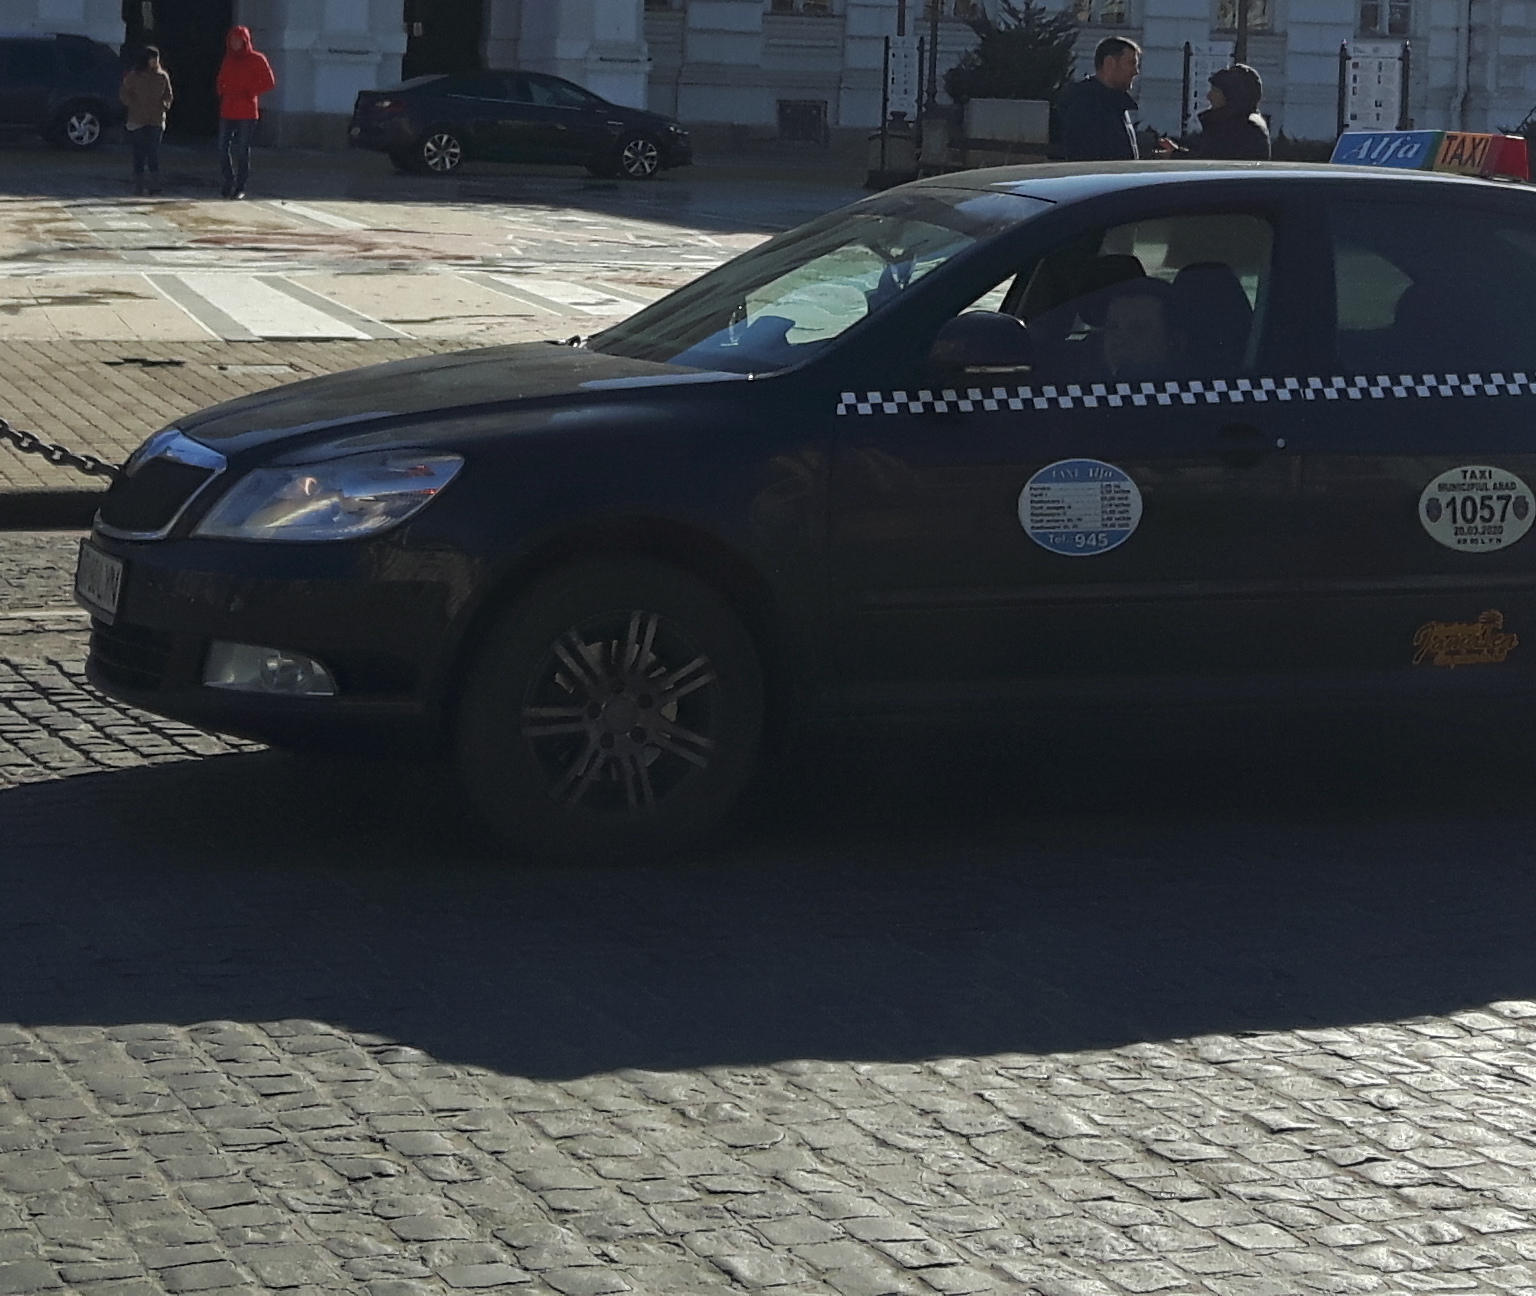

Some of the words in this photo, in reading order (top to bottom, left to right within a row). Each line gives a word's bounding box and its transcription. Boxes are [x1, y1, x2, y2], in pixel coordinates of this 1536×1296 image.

[1343, 134, 1423, 166] Alfa
[1440, 134, 1492, 169] TAXI
[1461, 469, 1493, 480] TAXI
[1492, 481, 1517, 491] ARAD
[1445, 494, 1513, 525] 1057
[1074, 533, 1109, 549] 945
